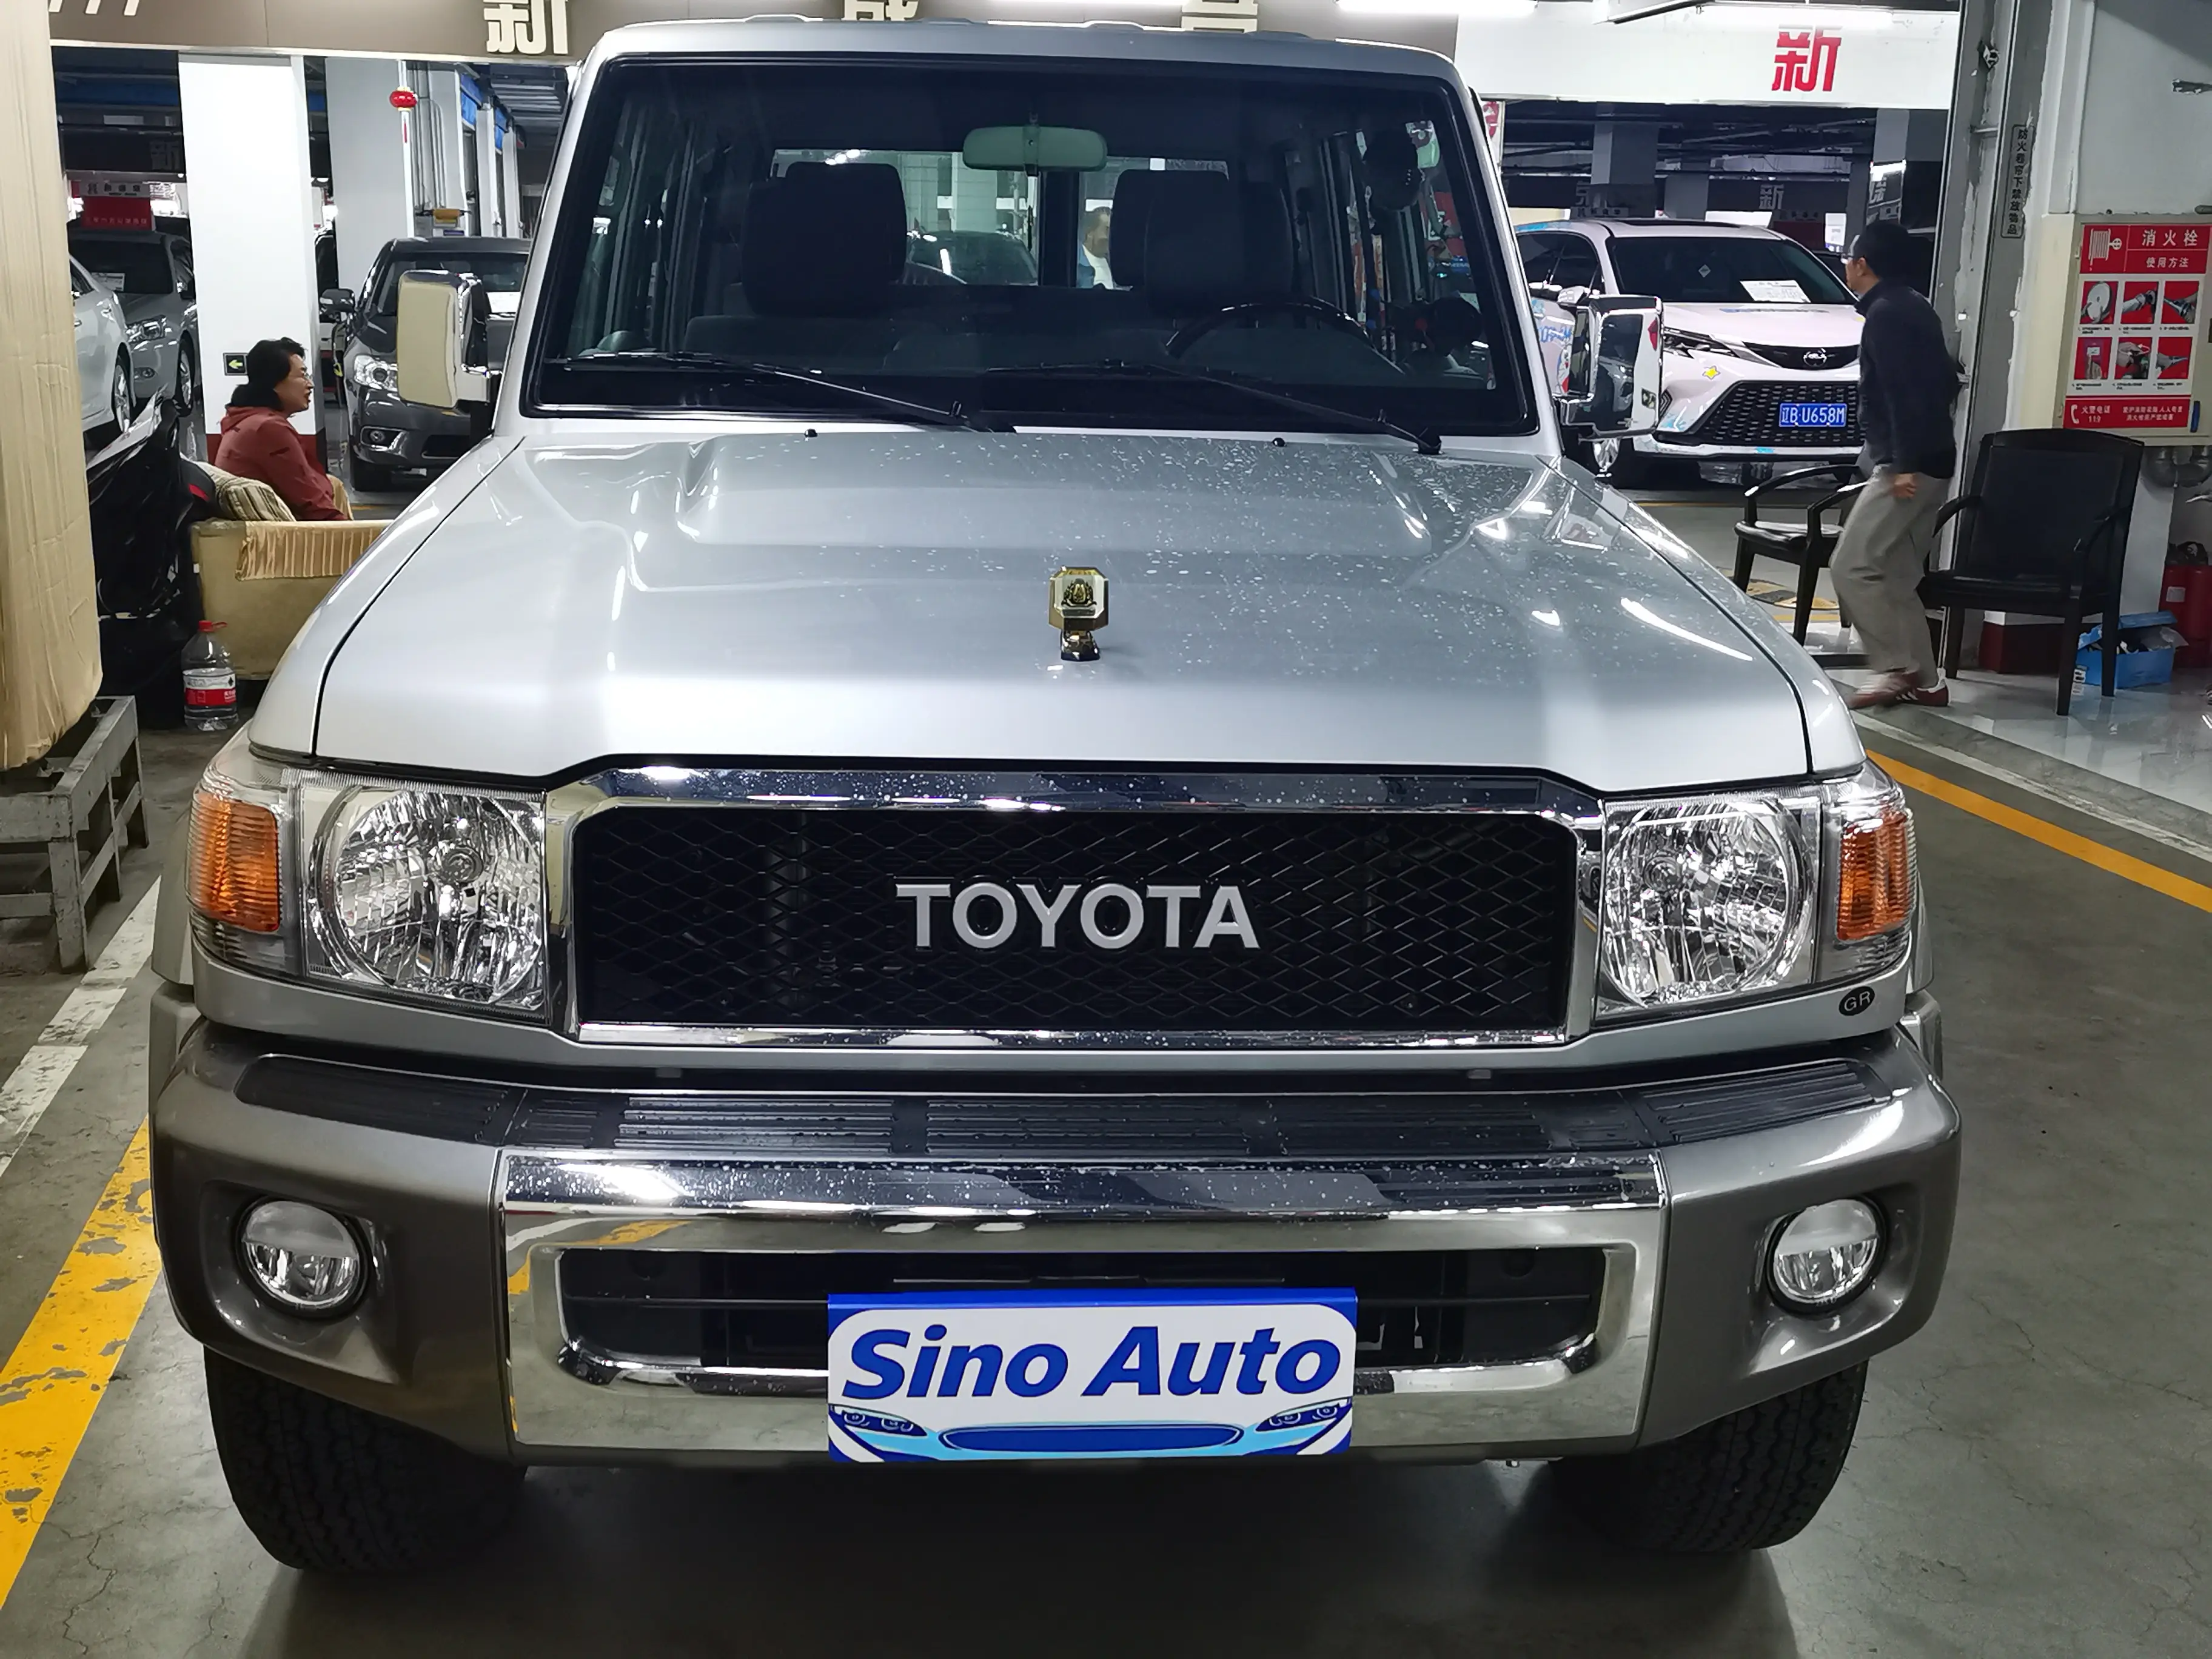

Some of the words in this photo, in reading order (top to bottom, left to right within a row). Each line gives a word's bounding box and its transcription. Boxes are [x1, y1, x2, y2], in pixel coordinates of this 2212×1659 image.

[1771, 24, 1843, 92] 新
[2142, 229, 2198, 247] 消火栓
[2146, 256, 2190, 268] 使用方法
[896, 882, 1260, 949] TOYOTA
[1844, 991, 1871, 1011] GR
[842, 1324, 1069, 1399] Sino
[1081, 1326, 1341, 1395] Auto
